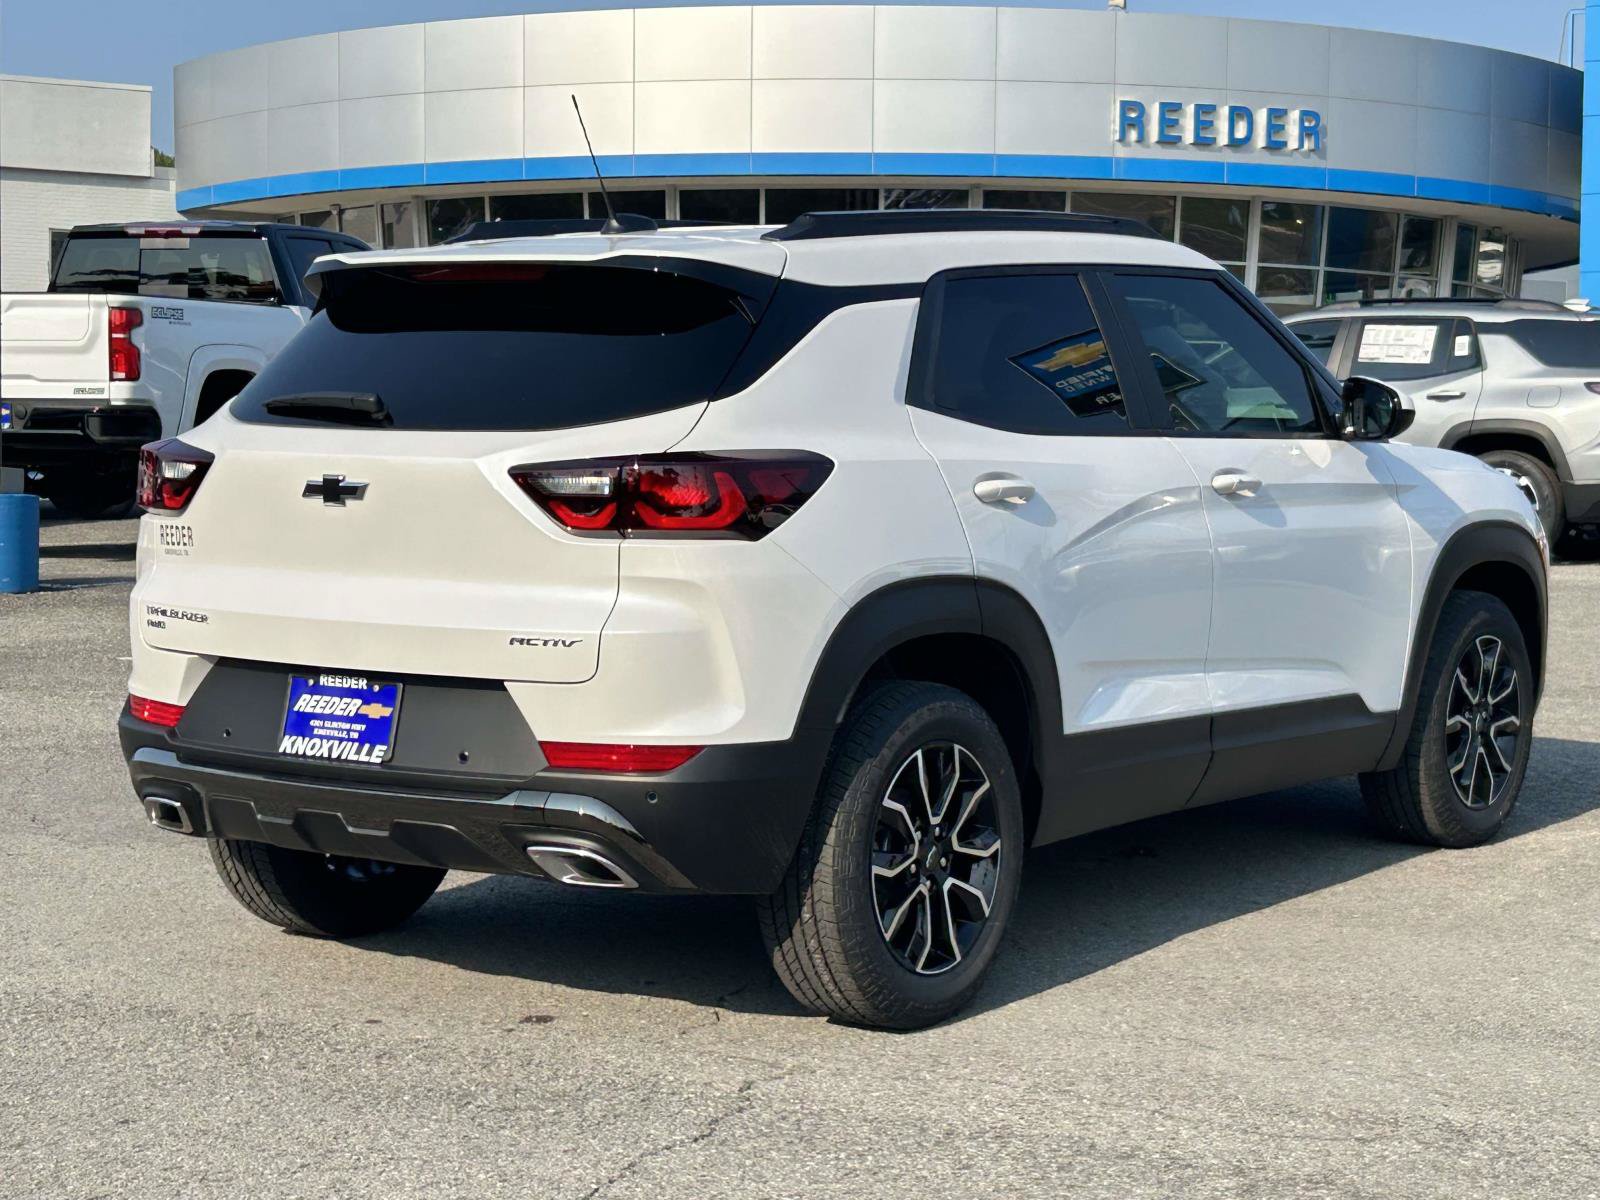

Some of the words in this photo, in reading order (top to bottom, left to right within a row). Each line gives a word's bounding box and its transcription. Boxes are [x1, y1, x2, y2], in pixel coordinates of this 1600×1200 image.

[1117, 99, 1322, 152] REEDER
[159, 524, 194, 547] REEDER
[508, 636, 584, 648] ACTIV
[319, 674, 368, 690] REEDER
[293, 693, 363, 717] REEDER
[278, 735, 388, 764] KNOXVILLE
